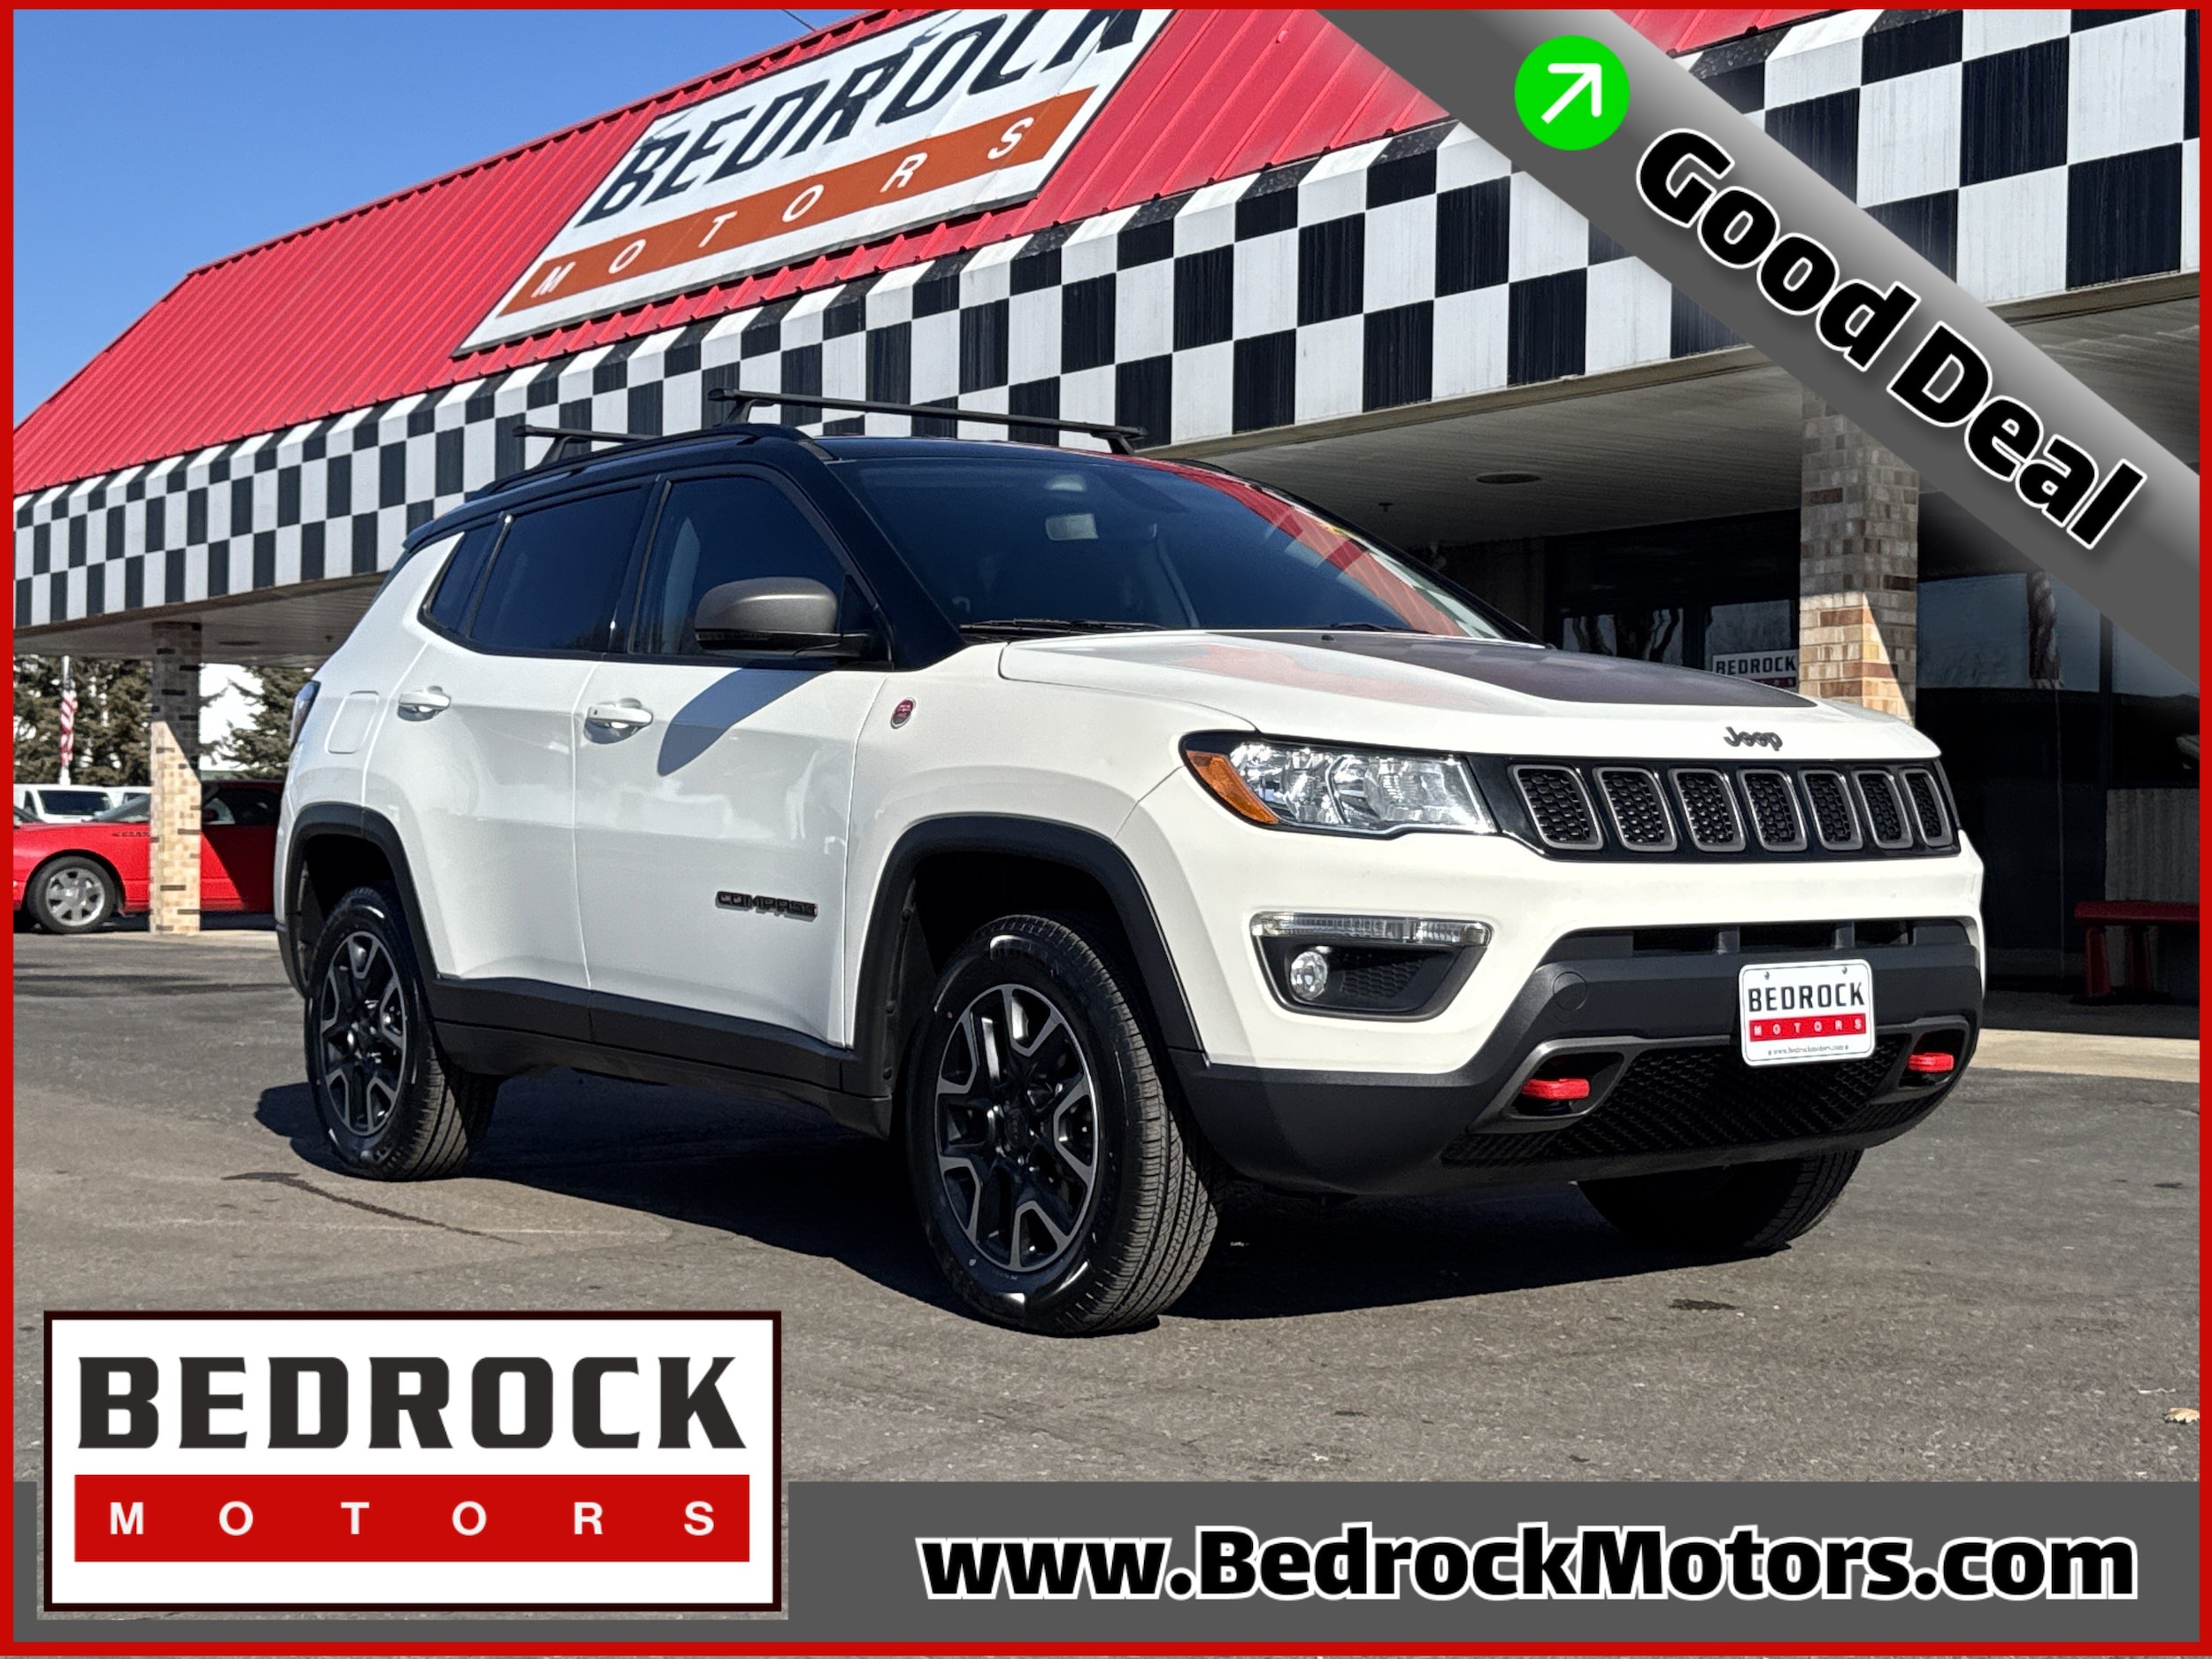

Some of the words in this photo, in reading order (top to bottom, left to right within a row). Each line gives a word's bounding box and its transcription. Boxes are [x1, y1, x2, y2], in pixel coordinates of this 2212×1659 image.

[531, 116, 1034, 298] MOTORS
[1717, 656, 1797, 675] BEDROCK
[1724, 726, 1783, 752] Jeep
[1748, 982, 1865, 1012] BEDROCK
[1754, 1018, 1863, 1036] MOTORS
